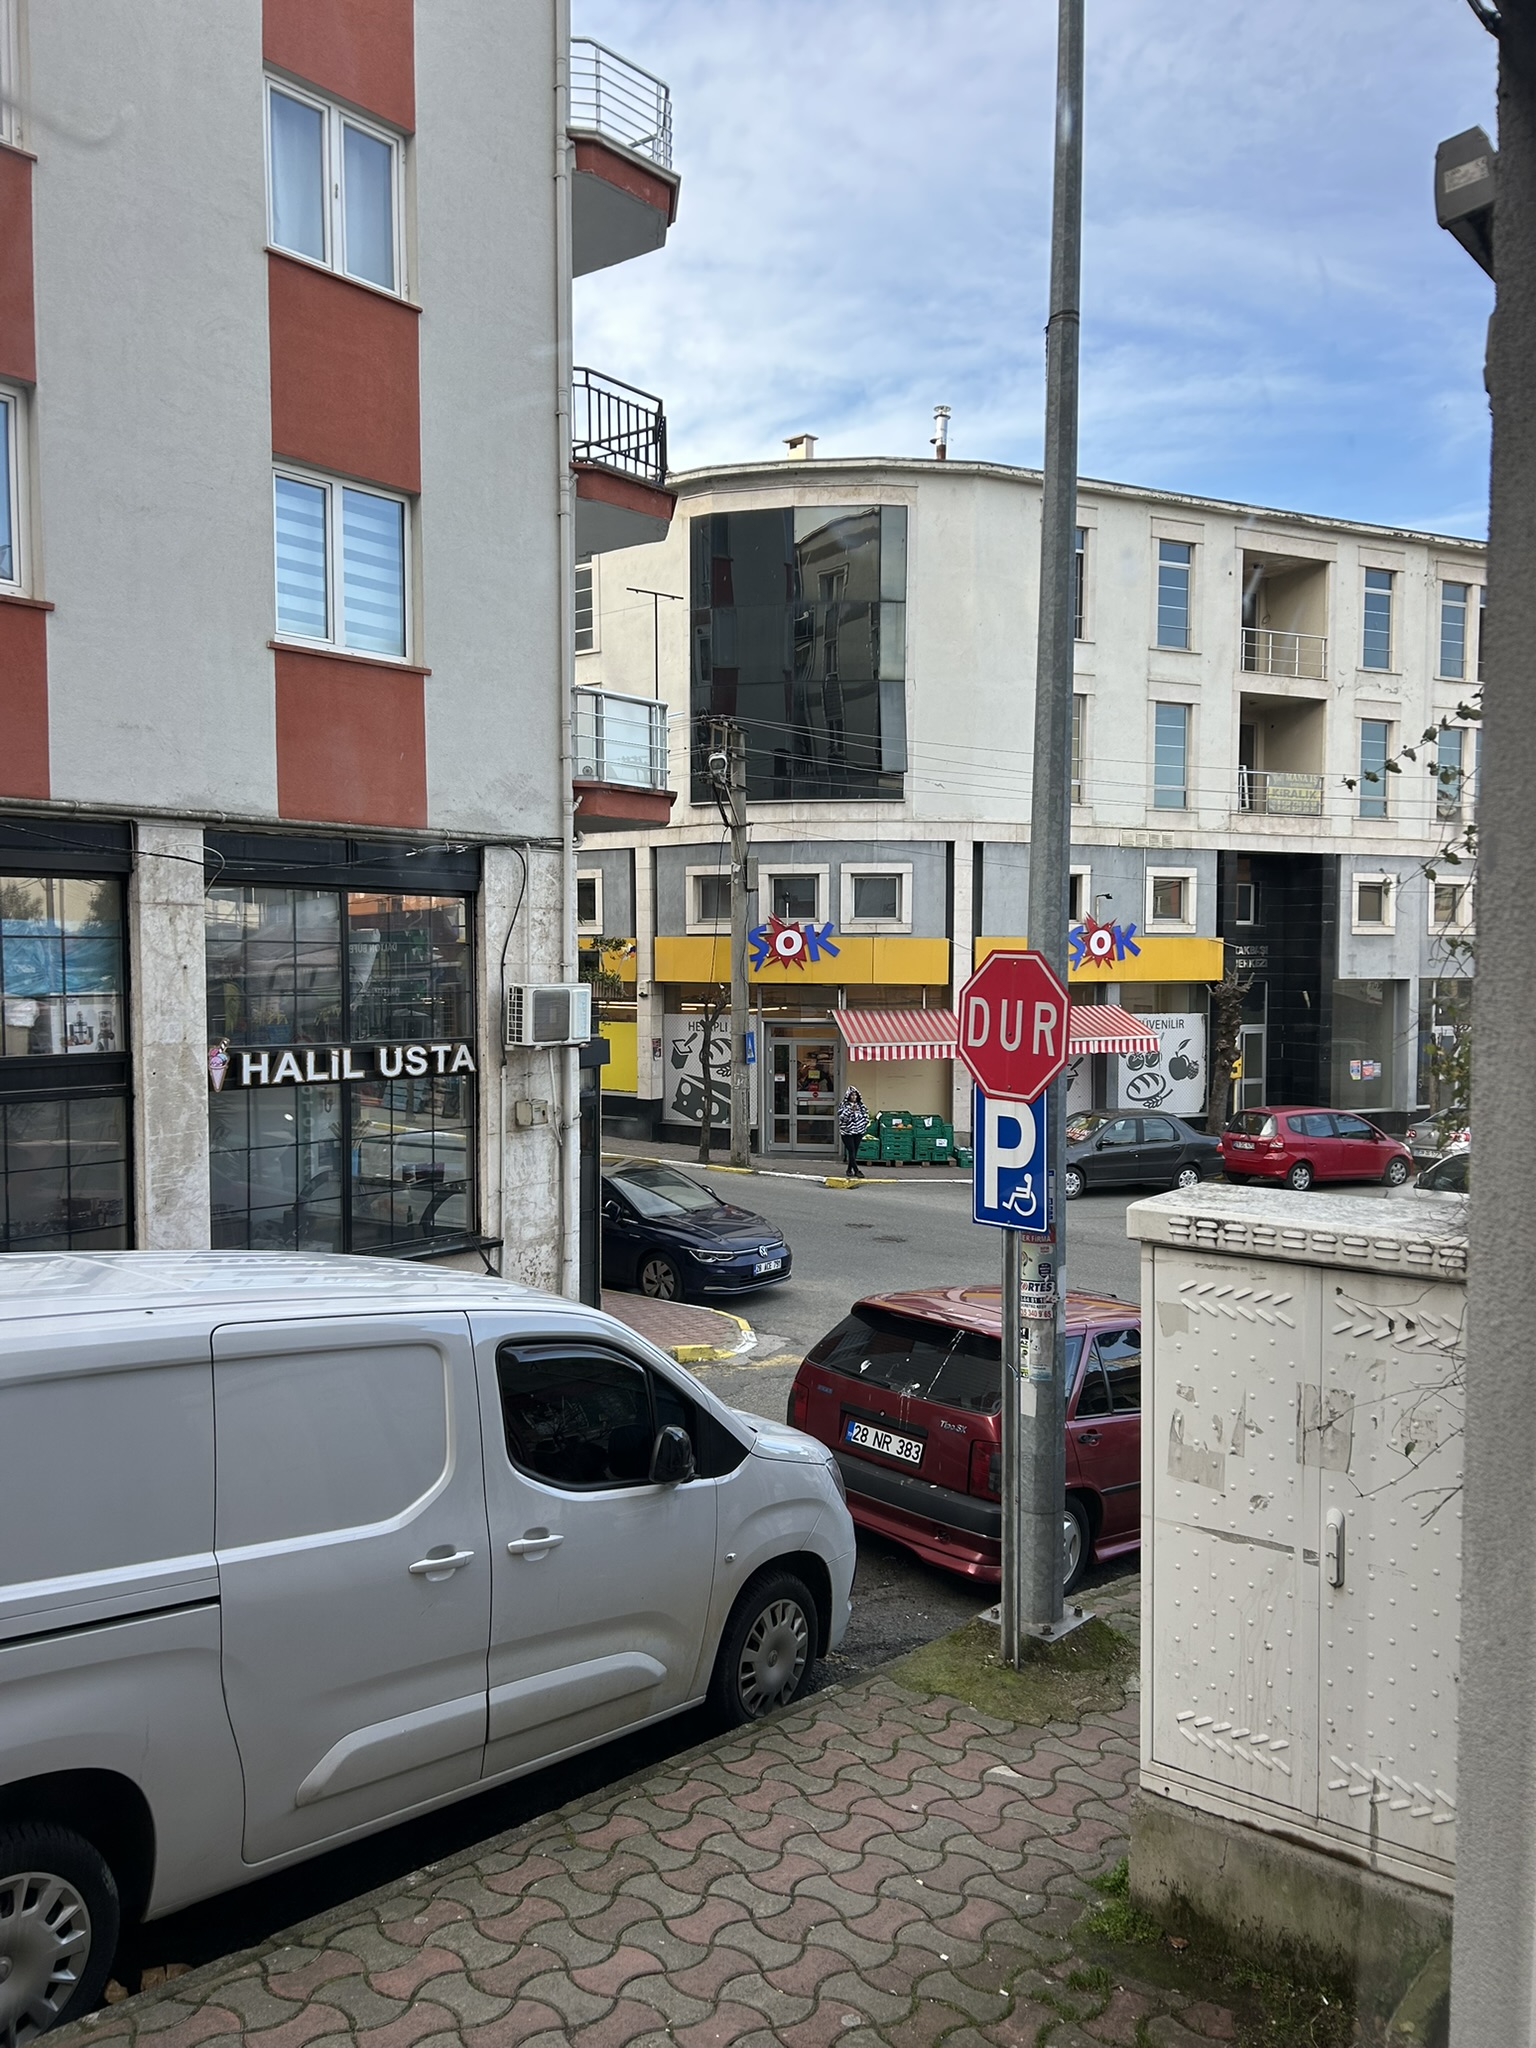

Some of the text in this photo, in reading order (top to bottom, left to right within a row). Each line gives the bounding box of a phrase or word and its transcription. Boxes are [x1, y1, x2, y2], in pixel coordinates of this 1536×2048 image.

[748, 922, 840, 972] ŞOK
[1068, 923, 1141, 971] ŞOK
[967, 996, 1057, 1057] DUR
[1141, 1018, 1185, 1029] ÜVENİLİR
[379, 1044, 477, 1078] USTA
[984, 1097, 1036, 1209] P
[853, 1425, 921, 1461] 28 NR 383
